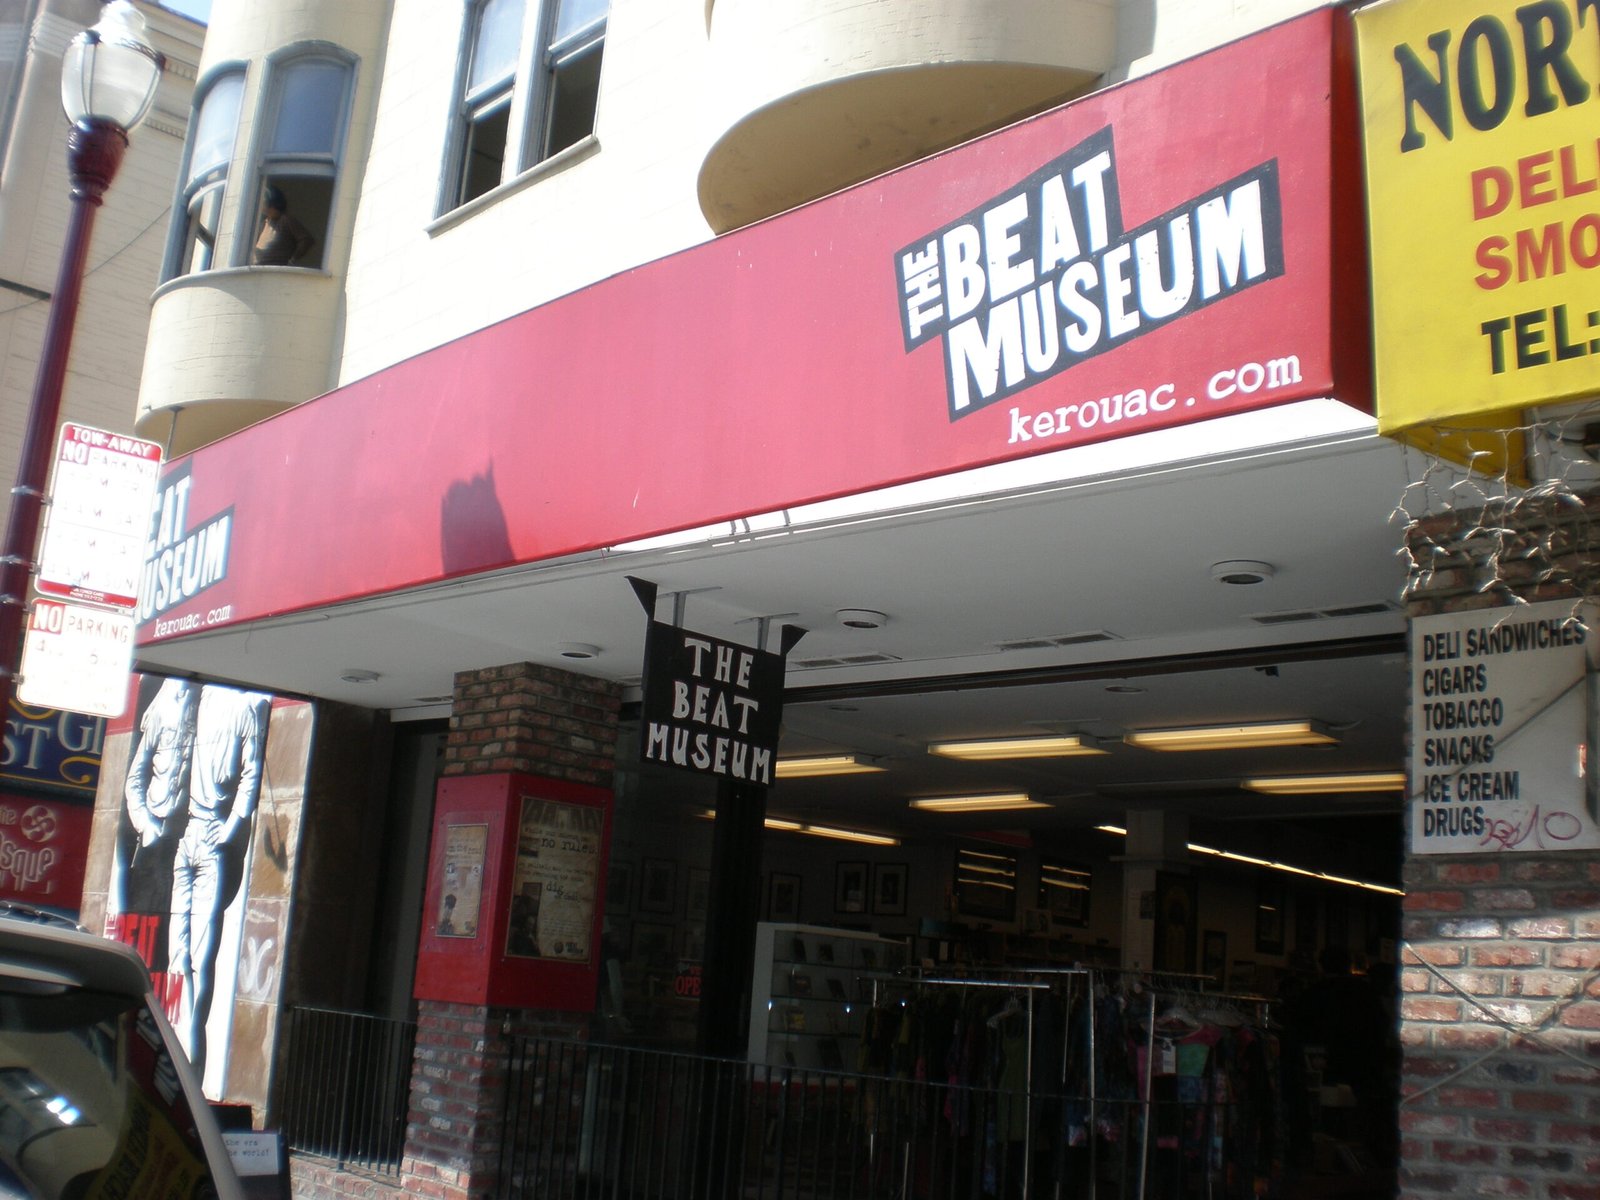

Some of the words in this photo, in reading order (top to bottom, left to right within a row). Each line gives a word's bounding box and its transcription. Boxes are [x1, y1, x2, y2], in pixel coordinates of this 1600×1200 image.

[942, 150, 1111, 322] BEAT
[901, 239, 945, 340] THE
[948, 180, 1267, 411] MUSEUM
[1481, 304, 1600, 375] TEL:
[1008, 354, 1302, 444] kerouac.com
[62, 441, 88, 464] NO
[73, 427, 151, 457] TOW-AWAY
[33, 604, 62, 632] NO
[68, 616, 129, 643] PARKING
[1423, 631, 1461, 662] DELI
[1466, 616, 1587, 657] SANDWICHES
[684, 637, 754, 689] THE
[1423, 664, 1487, 697] CIGARS
[672, 680, 759, 735] BEAT
[1423, 698, 1504, 731] TOBACCO
[646, 722, 771, 785] MUSEUM
[1424, 734, 1495, 767] SNACKS
[1424, 774, 1451, 803] ICE
[1457, 771, 1520, 801] CREAM
[1423, 806, 1485, 838] DRUGS
[675, 975, 701, 996] OPE
